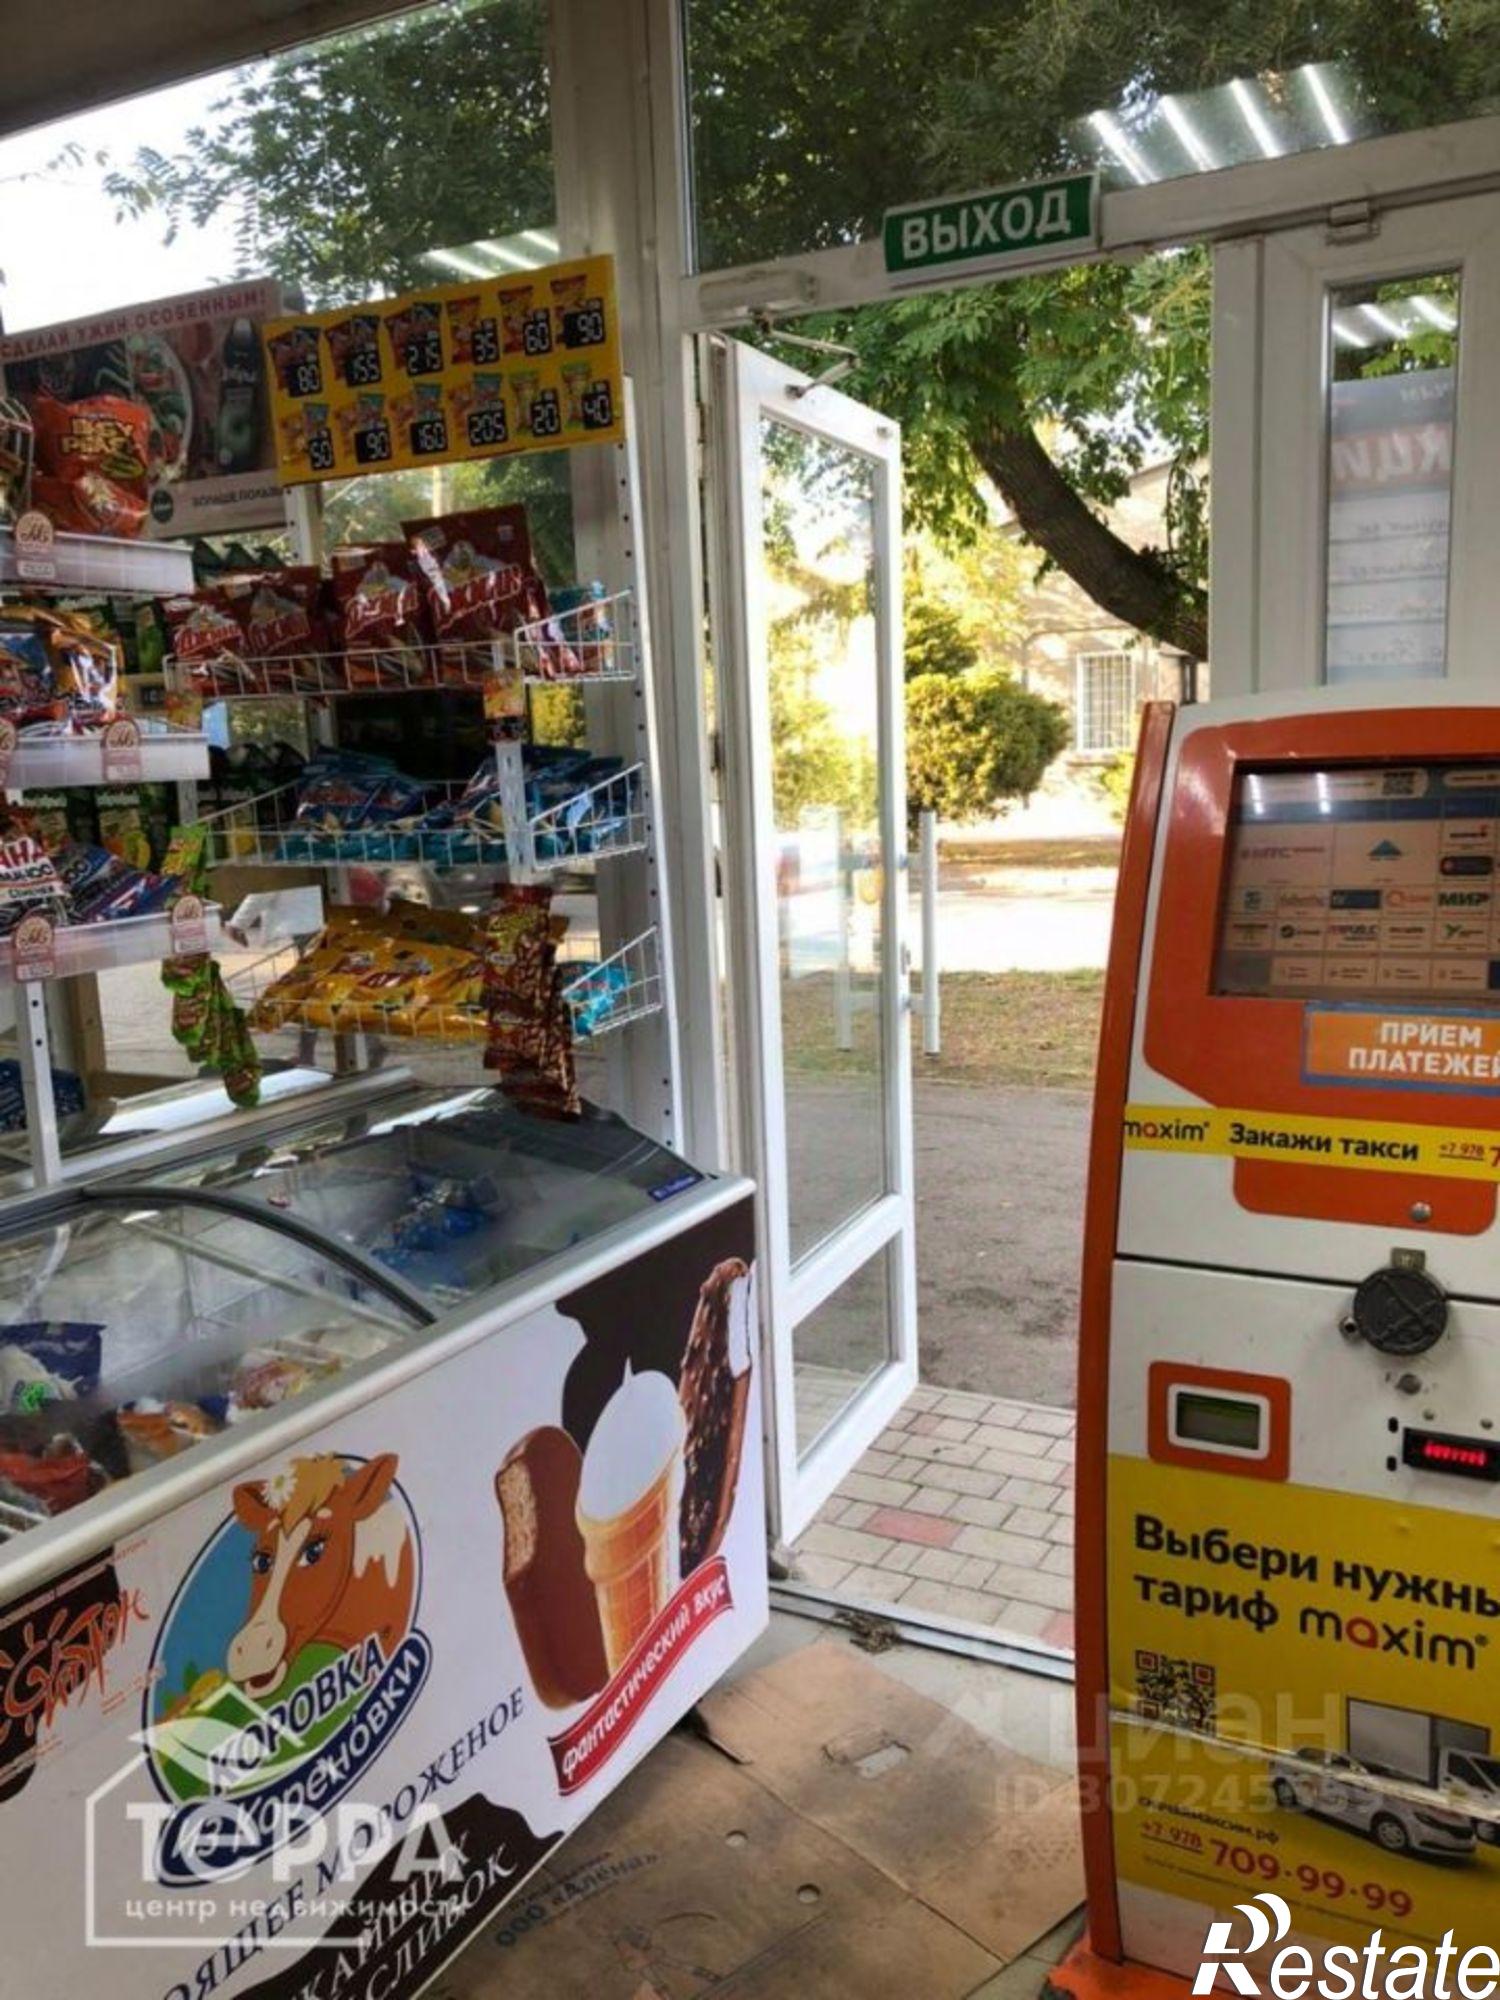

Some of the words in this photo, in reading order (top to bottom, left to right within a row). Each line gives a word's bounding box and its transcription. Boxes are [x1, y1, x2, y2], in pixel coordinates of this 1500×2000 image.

[902, 188, 1072, 260] ВЫХОД
[78, 315, 127, 342] УЖИН
[525, 323, 550, 353] 60
[576, 312, 603, 343] 90
[474, 332, 497, 362] 35
[297, 364, 320, 392] 80
[533, 403, 558, 433] 20
[584, 394, 611, 424] 40
[469, 412, 506, 444] 205
[1438, 891, 1490, 907] МИР
[1380, 1021, 1483, 1049] ПРИЕМ
[1228, 1122, 1333, 1154] Закажи
[1339, 1137, 1420, 1161] такси
[1135, 1513, 1318, 1583] Выбери
[1134, 1573, 1280, 1633] тариф
[561, 1603, 691, 1778] фантастический
[693, 1573, 726, 1624] вкус
[208, 1634, 385, 1796] КОРОВКА
[316, 1686, 525, 1899] МОРОЖЕНОЕ
[365, 1845, 518, 1996] СЛИВОК
